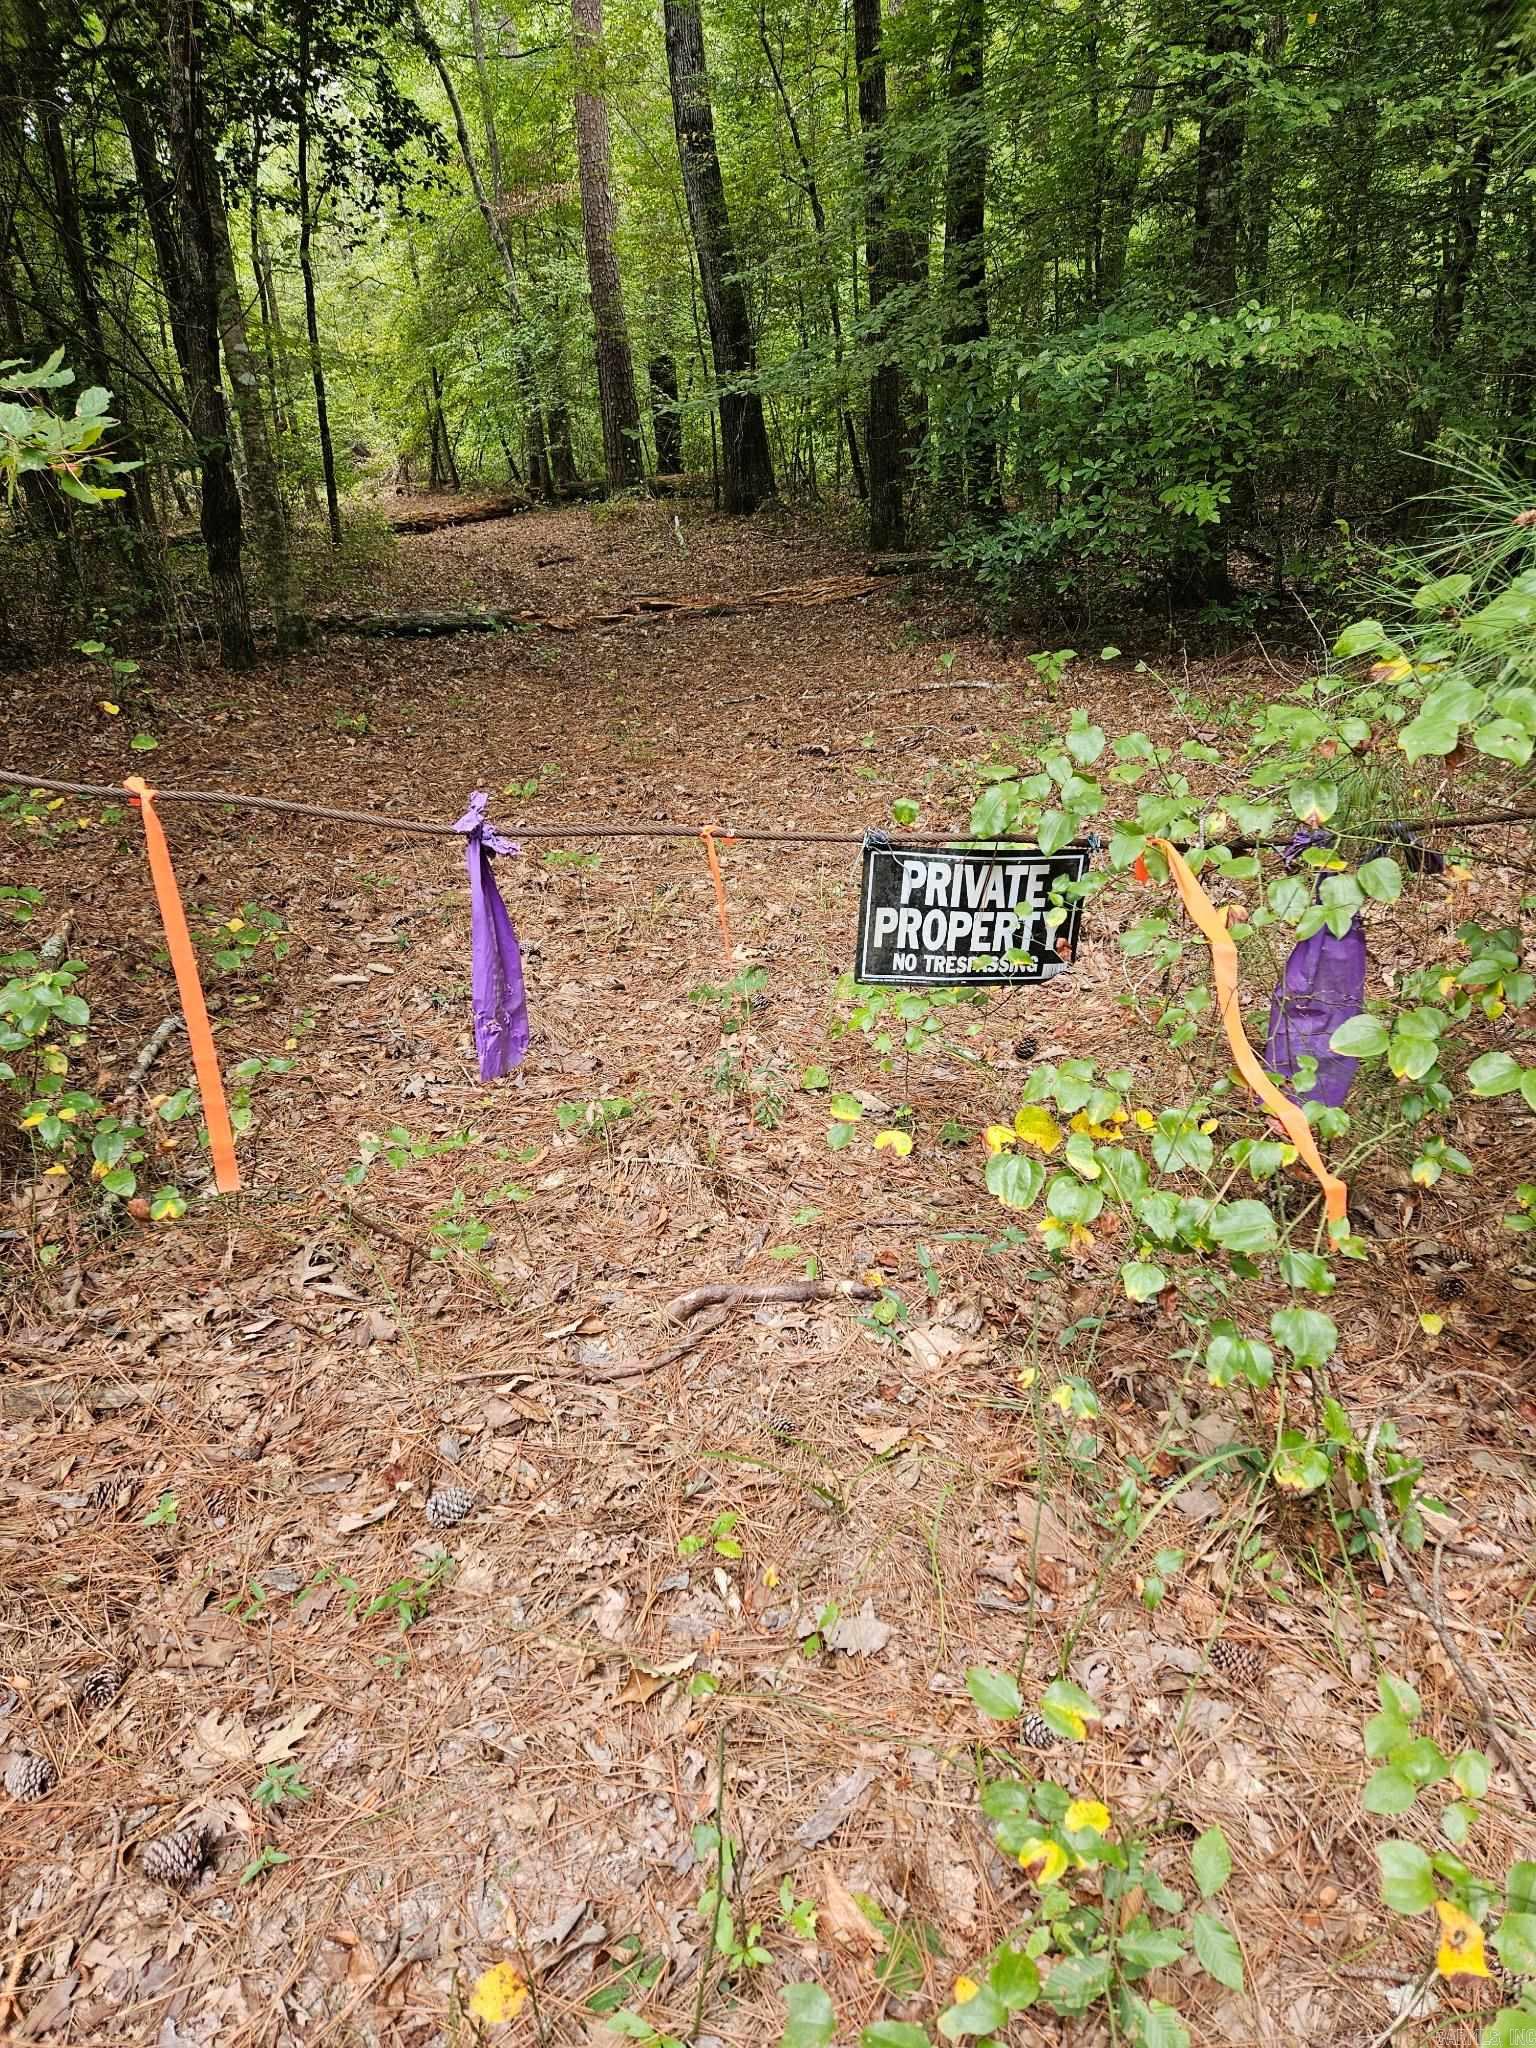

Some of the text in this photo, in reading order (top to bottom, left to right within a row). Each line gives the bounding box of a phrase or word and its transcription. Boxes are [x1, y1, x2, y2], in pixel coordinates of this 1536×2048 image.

[900, 860, 1050, 908] PRIVATE
[873, 907, 1065, 951] PROPERTY
[892, 953, 918, 972] NO
